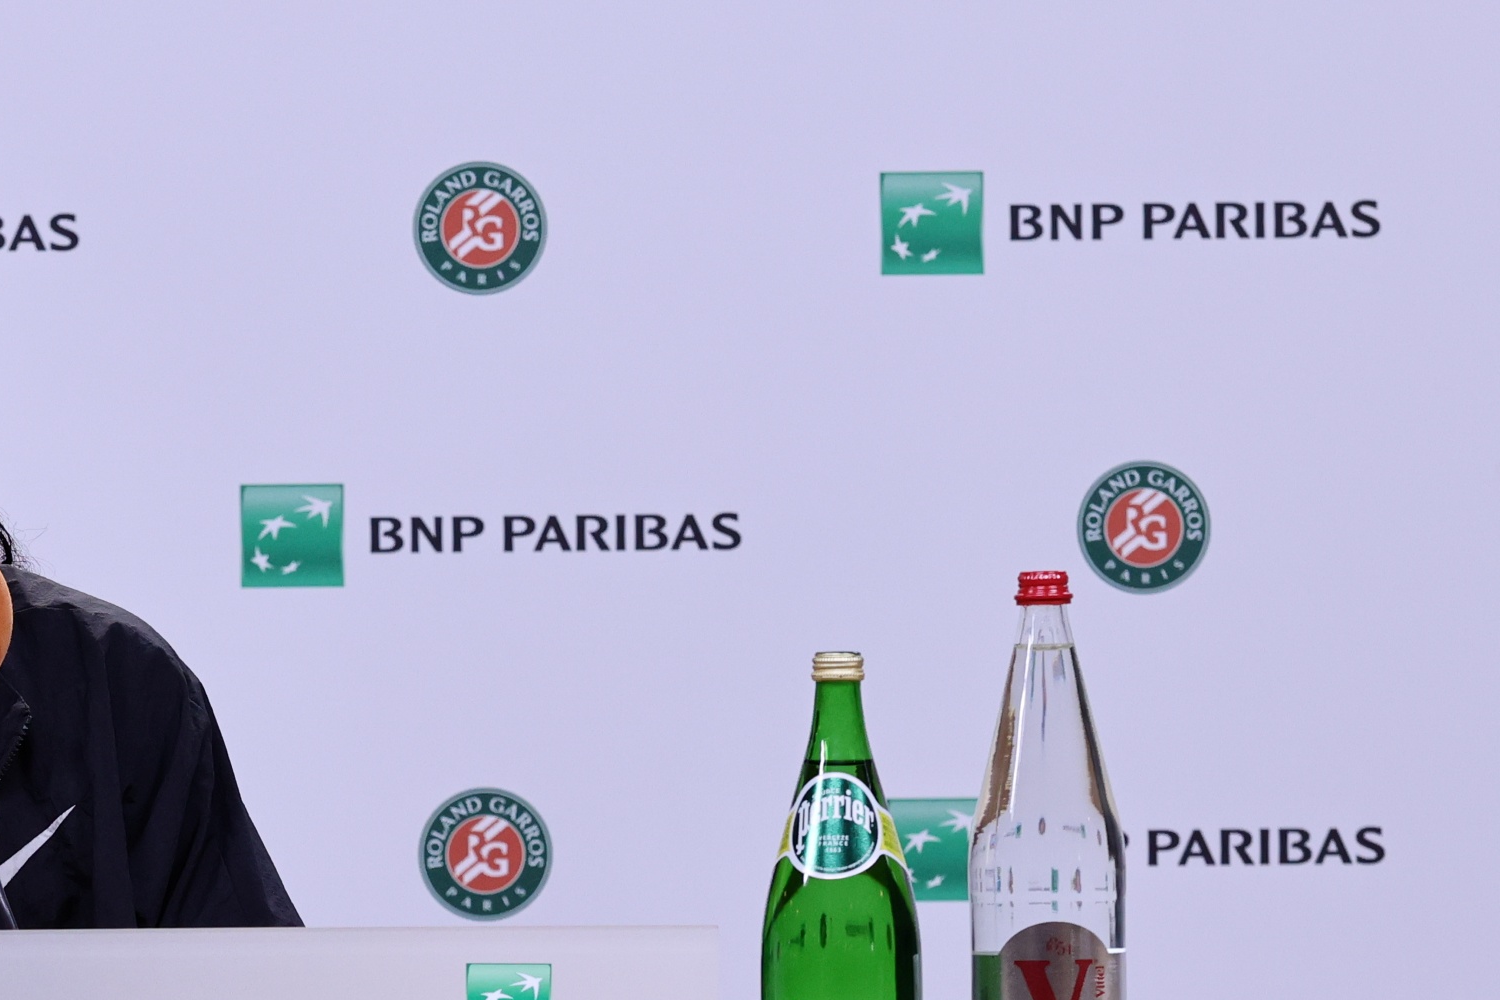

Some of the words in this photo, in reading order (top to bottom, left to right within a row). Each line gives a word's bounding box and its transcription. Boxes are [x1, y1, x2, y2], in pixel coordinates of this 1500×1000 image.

[421, 170, 477, 243] ROLAND
[483, 170, 540, 242] GARROS
[1010, 203, 1124, 241] BNP
[1143, 200, 1381, 240] PARIBAS
[440, 260, 521, 285] PARIS
[1085, 469, 1141, 542] ROLAND
[1147, 470, 1203, 541] GARROS
[370, 516, 484, 553] BNP
[503, 512, 742, 552] PARIBAS
[1104, 559, 1185, 584] PARIS
[427, 796, 482, 869] ROLAND
[489, 797, 545, 868] GARROS
[1148, 827, 1385, 866] PARIBAS
[446, 886, 526, 912] PARIS
